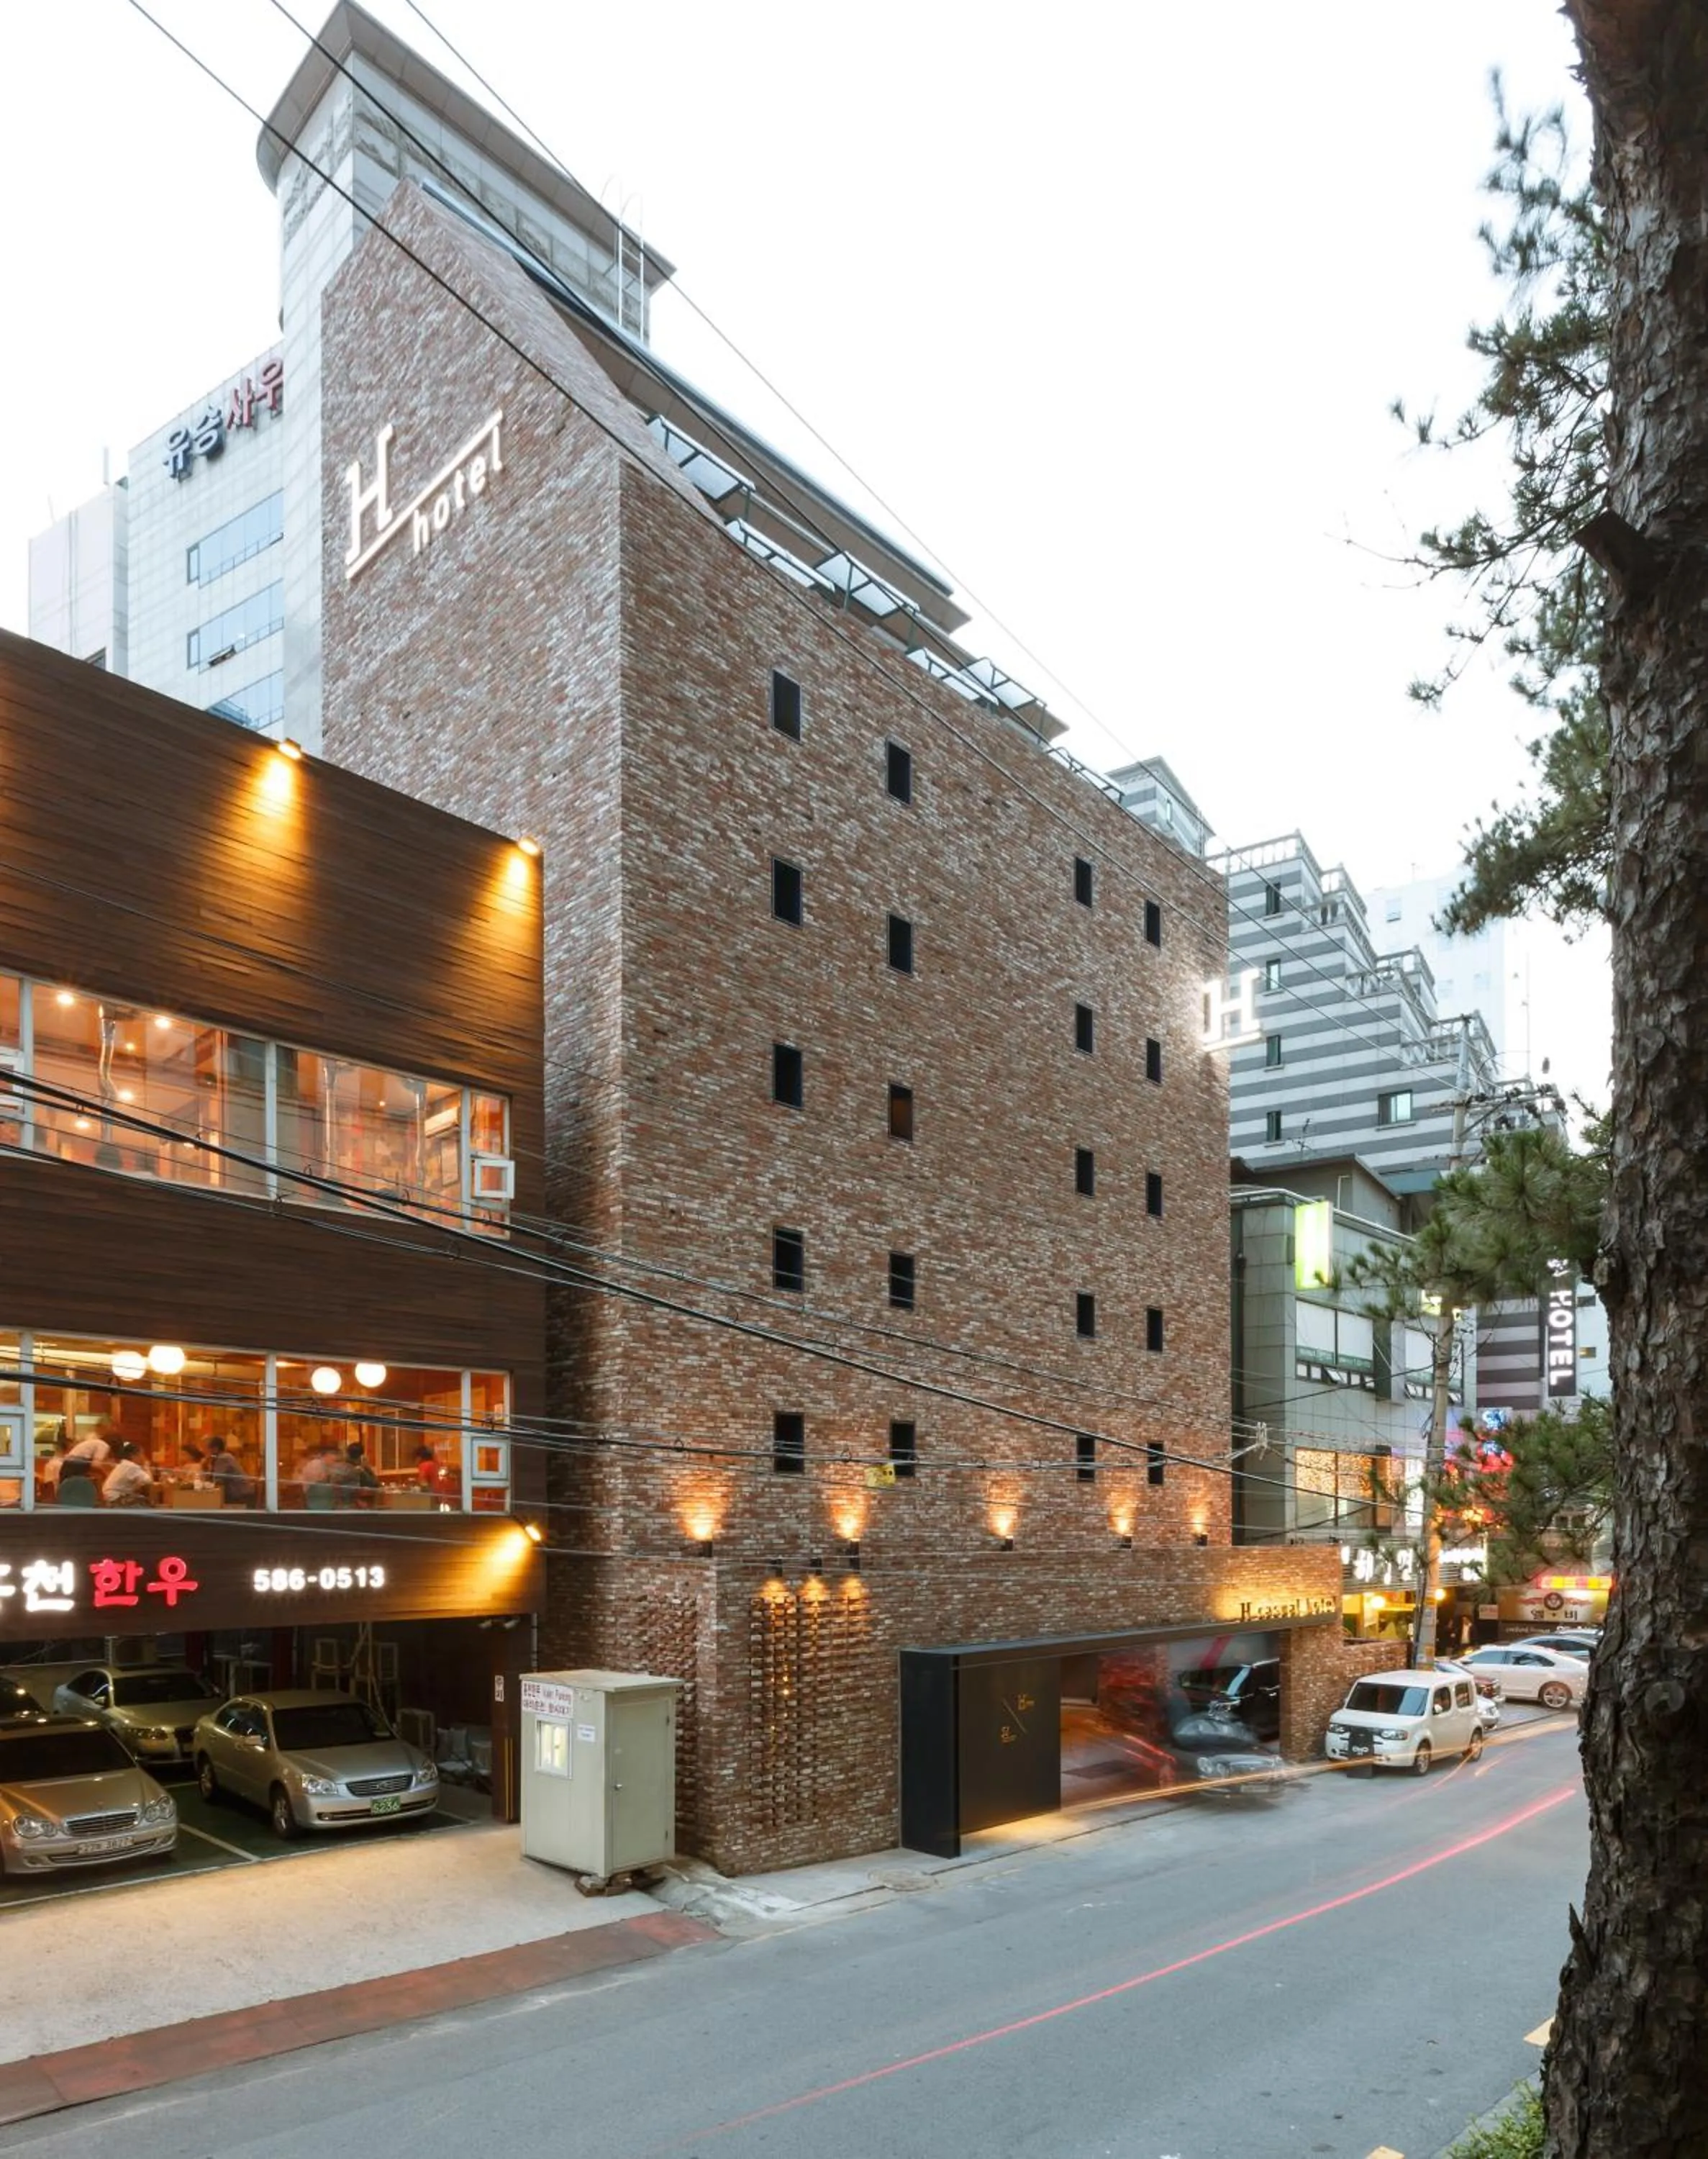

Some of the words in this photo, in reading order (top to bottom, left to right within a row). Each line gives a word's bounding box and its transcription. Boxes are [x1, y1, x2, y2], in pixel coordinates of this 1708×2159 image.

[345, 424, 394, 565] H
[412, 425, 503, 555] hotel
[1201, 968, 1260, 1041] H
[1548, 1290, 1573, 1386] HOTEL
[89, 1557, 199, 1607] 한우
[253, 1565, 385, 1591] 586-0513
[1240, 1601, 1251, 1622] H
